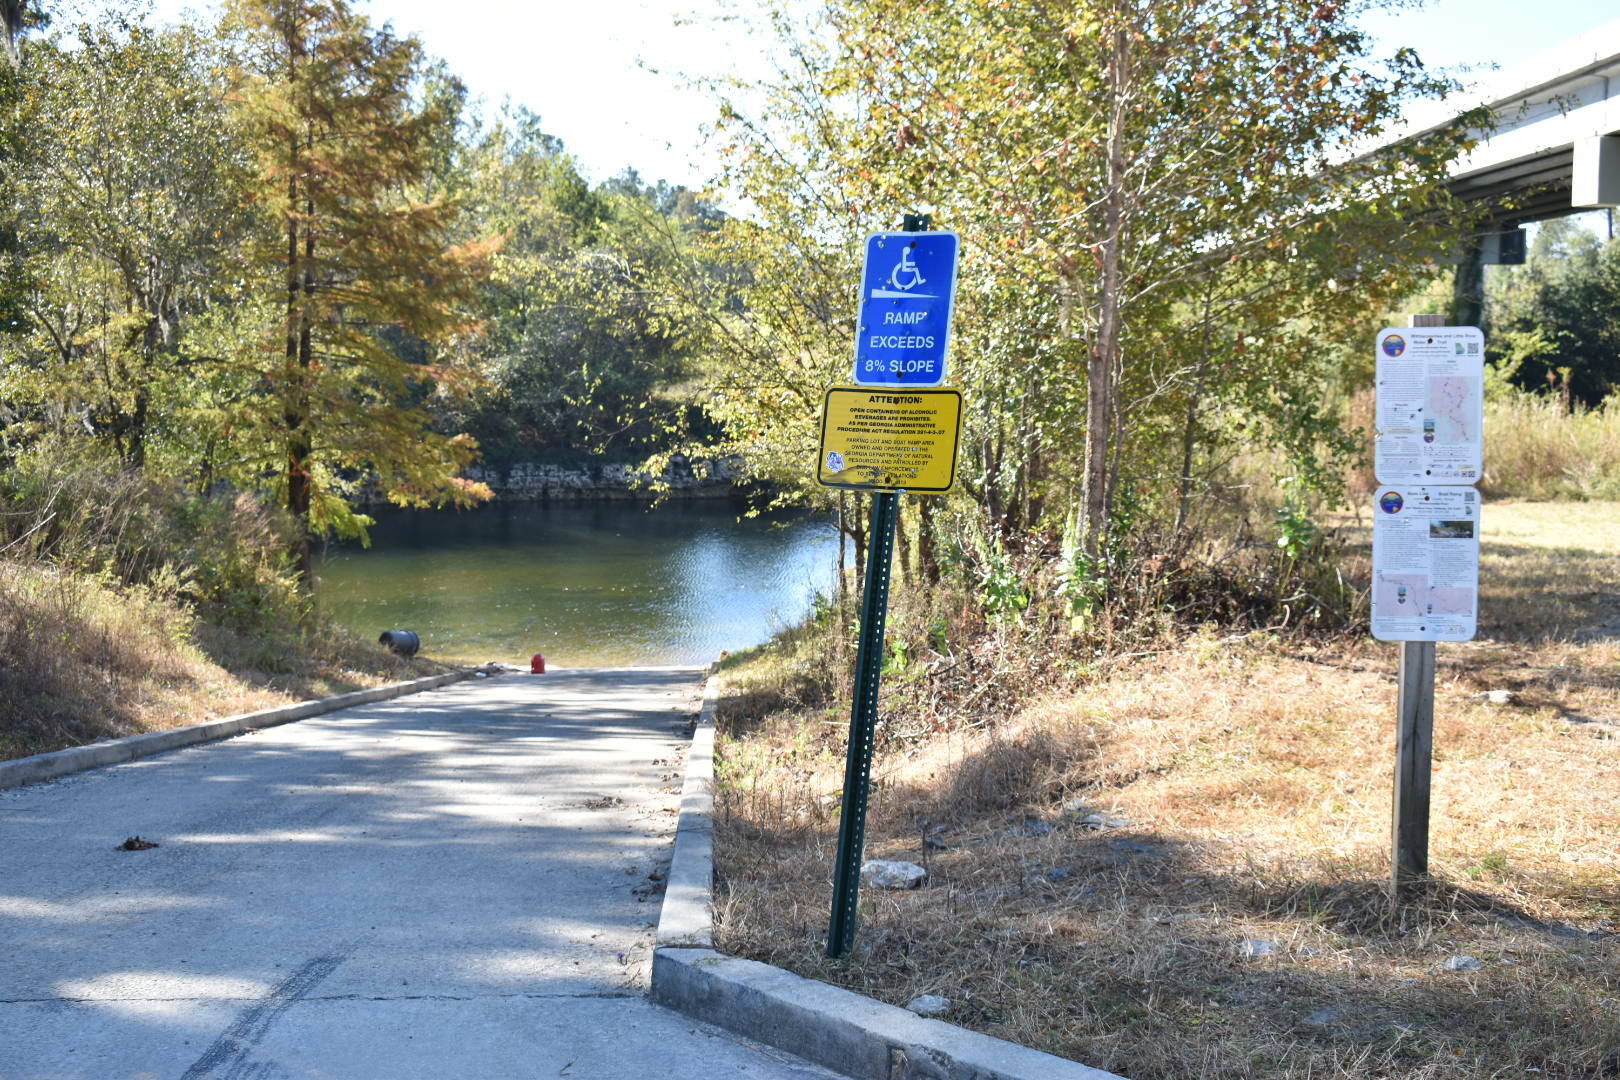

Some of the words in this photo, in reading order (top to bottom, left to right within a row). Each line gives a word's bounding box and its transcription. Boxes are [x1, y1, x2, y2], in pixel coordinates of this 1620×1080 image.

[885, 311, 925, 325] RAMP
[870, 335, 935, 349] EXCEEDS
[865, 359, 885, 372] 8%
[889, 360, 935, 373] SLOPE
[869, 395, 923, 404] ATTENTION:
